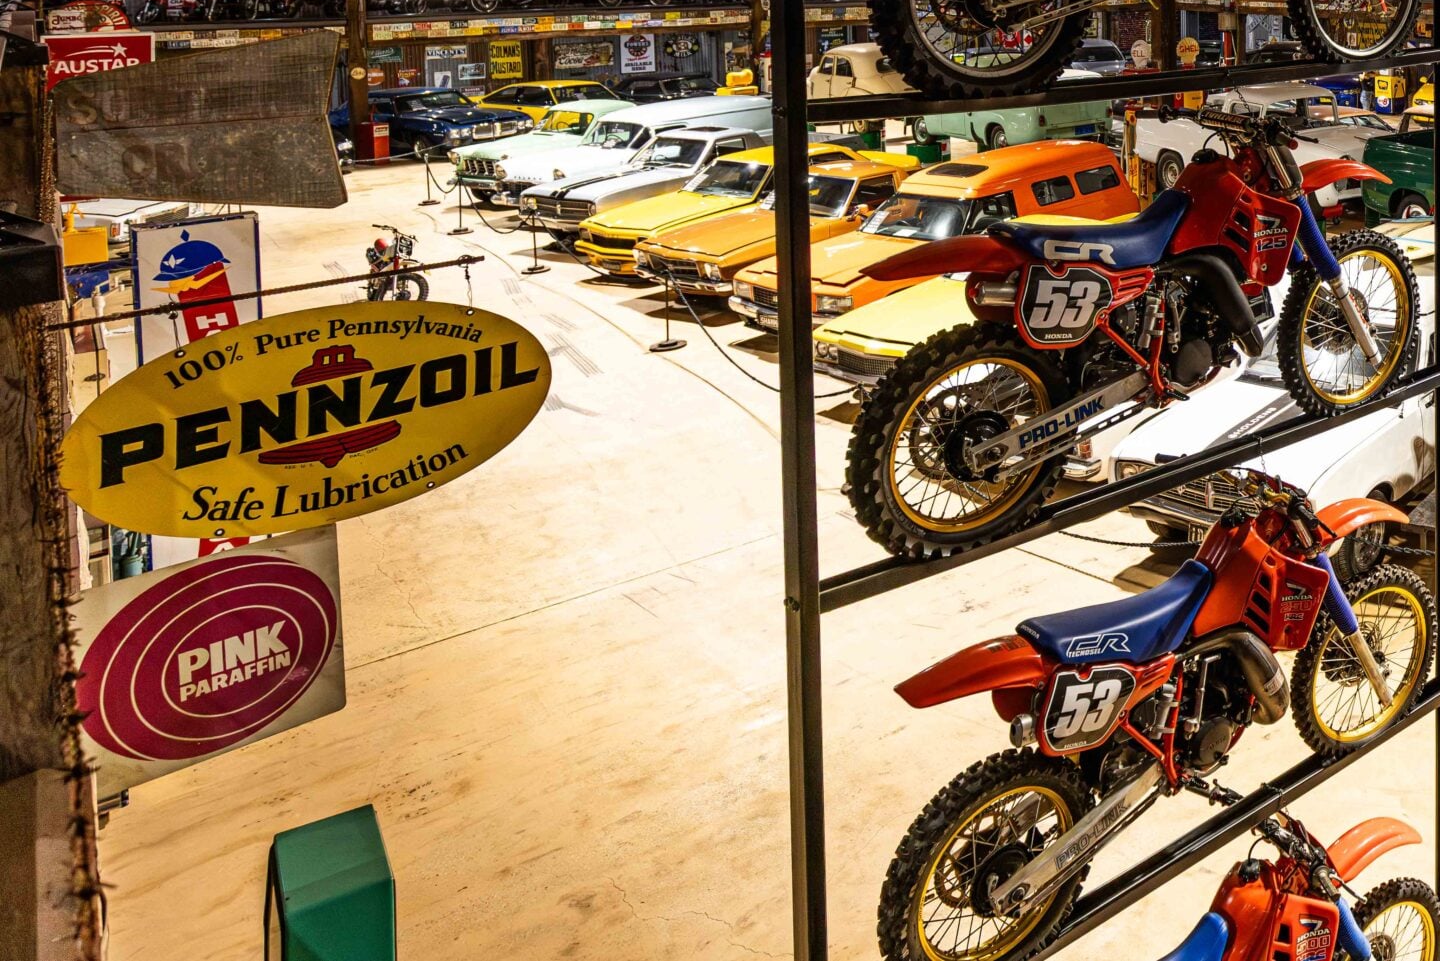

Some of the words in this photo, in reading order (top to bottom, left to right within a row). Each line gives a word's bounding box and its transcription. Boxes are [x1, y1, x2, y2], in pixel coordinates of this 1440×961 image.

[490, 44, 520, 58] COLMAN'S
[491, 61, 521, 74] MUSTARD
[1253, 227, 1289, 238] HONDA
[1255, 237, 1288, 252] 125
[1029, 279, 1101, 329] 53
[164, 342, 244, 390] 100%
[256, 329, 321, 357] Pure
[327, 315, 483, 343] Pennsylvania
[98, 342, 540, 490] PENNZOIL
[1018, 396, 1106, 448] PRO-LINK
[182, 486, 264, 522] Safe
[272, 442, 469, 518] Lubrication
[1281, 593, 1314, 602] HONDA
[177, 621, 290, 685] PINK
[179, 651, 292, 703] PARAFFIN
[1052, 678, 1123, 739] 53
[1064, 740, 1088, 750] HONDA
[1055, 800, 1132, 870] PRO-LINK
[1297, 928, 1330, 943] HONDA
